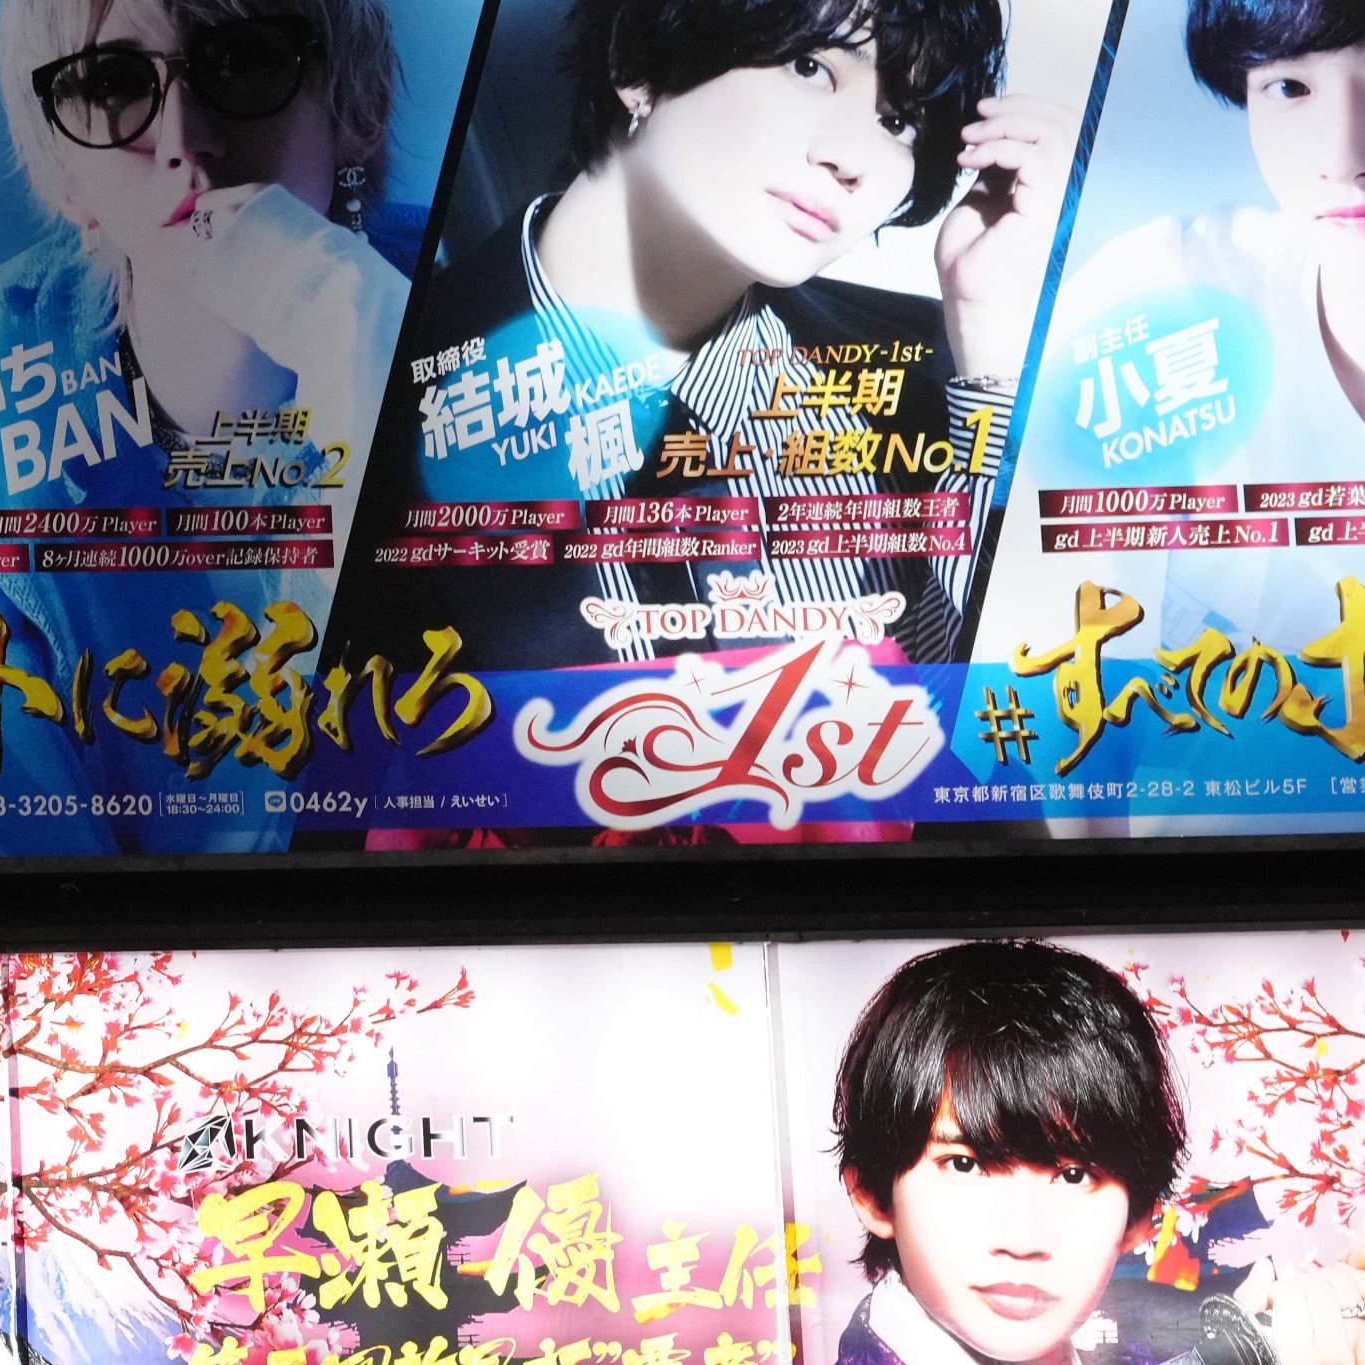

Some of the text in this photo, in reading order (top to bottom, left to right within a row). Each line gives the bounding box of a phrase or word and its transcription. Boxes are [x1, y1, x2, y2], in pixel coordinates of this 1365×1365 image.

[410, 335, 488, 386] 取締役
[737, 346, 787, 367] TOP
[1073, 313, 1151, 365] 副主任
[60, 351, 123, 396] BAN
[574, 352, 664, 407] KAEDE
[750, 367, 905, 420] 上半期
[1074, 316, 1229, 439] 小夏
[194, 407, 313, 446] 上半期
[418, 341, 570, 461] 結城
[0, 376, 156, 497] BAN
[490, 427, 559, 468] YUKI
[565, 401, 644, 494] 楓
[1101, 394, 1237, 470] KONATSU
[637, 605, 849, 635] TOP DANDY
